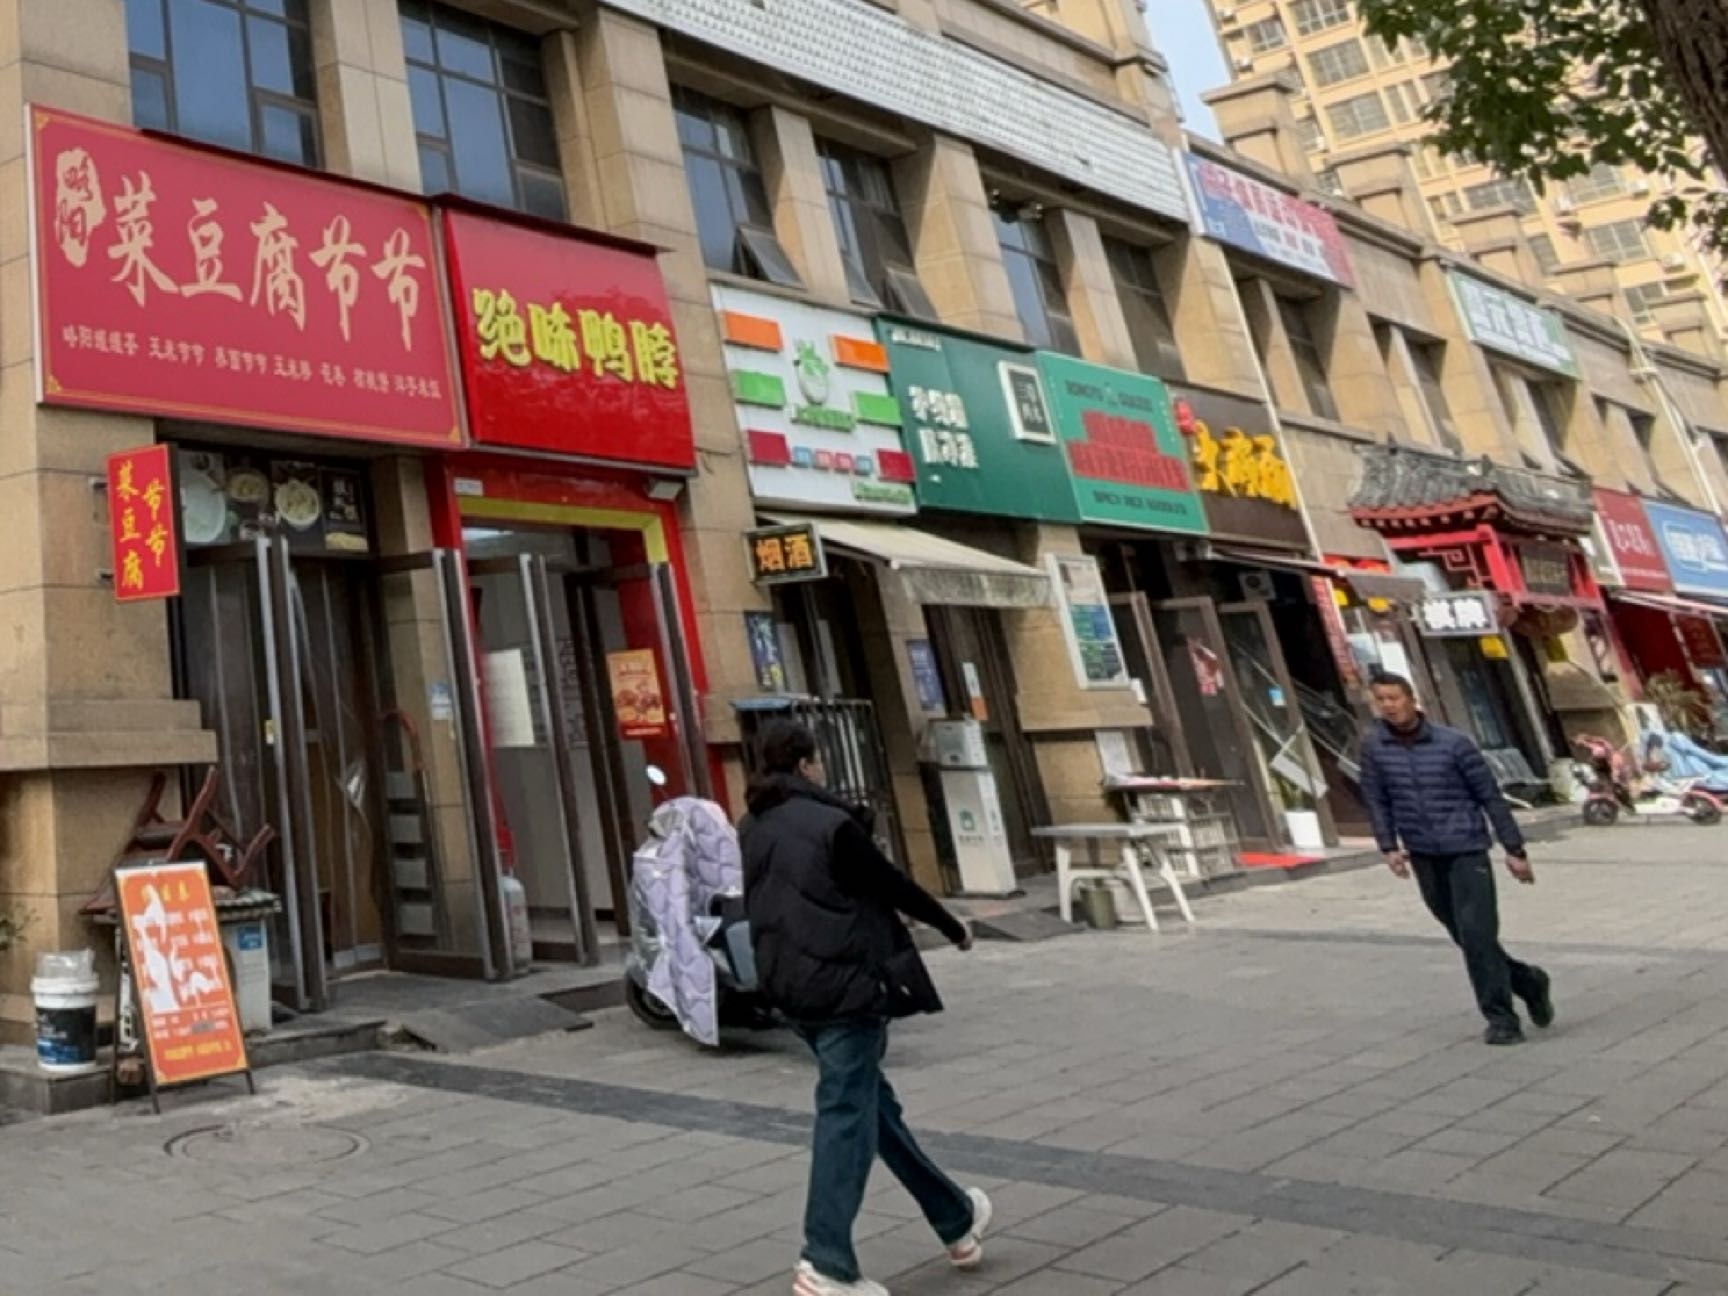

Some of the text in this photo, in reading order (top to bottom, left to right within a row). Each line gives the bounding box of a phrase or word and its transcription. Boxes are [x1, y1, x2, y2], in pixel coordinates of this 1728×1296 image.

[108, 170, 426, 352] 菜豆腐节节
[474, 288, 678, 391] 绝味鸭脖
[115, 459, 145, 591] 菜豆腐
